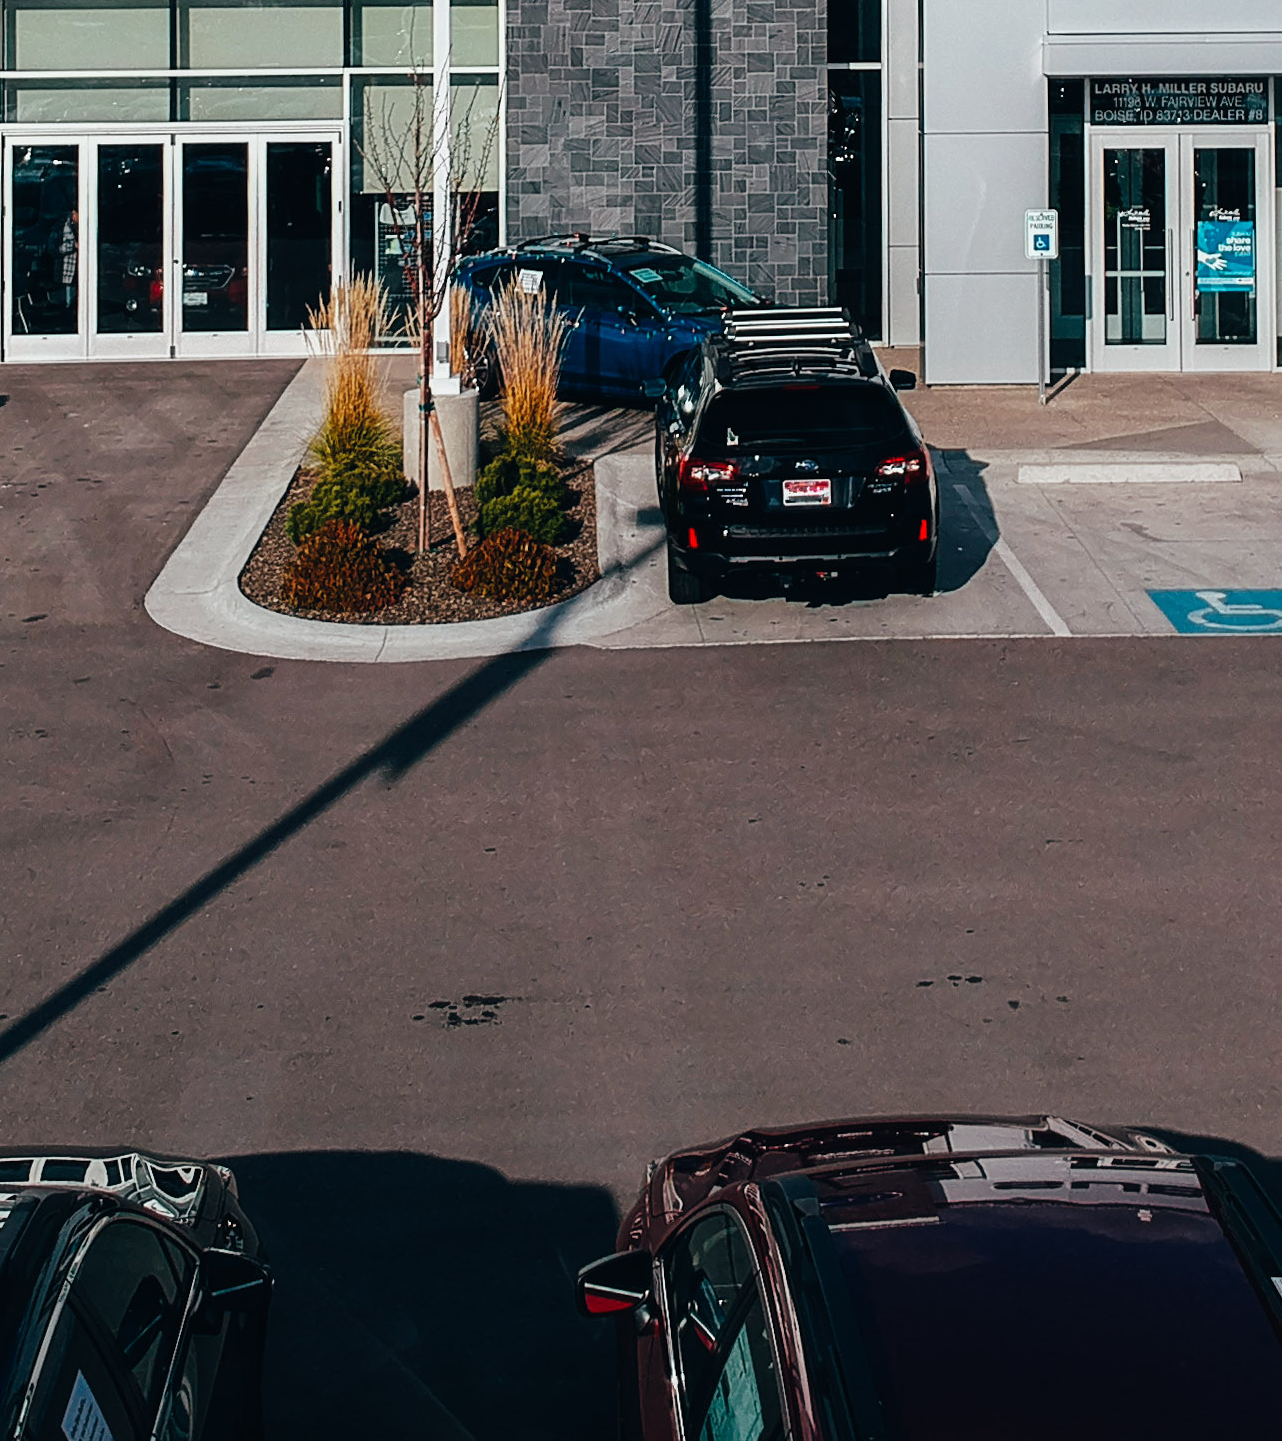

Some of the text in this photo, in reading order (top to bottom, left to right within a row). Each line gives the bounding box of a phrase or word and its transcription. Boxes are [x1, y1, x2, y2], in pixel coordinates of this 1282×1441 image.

[1095, 83, 1264, 94] LARRY H. MILLER SUBARU
[1145, 97, 1159, 107] W.
[1161, 97, 1217, 107] FAIRVIEW
[1219, 96, 1246, 107] AVE.
[1139, 110, 1153, 121] ID
[1248, 109, 1263, 121] #8
